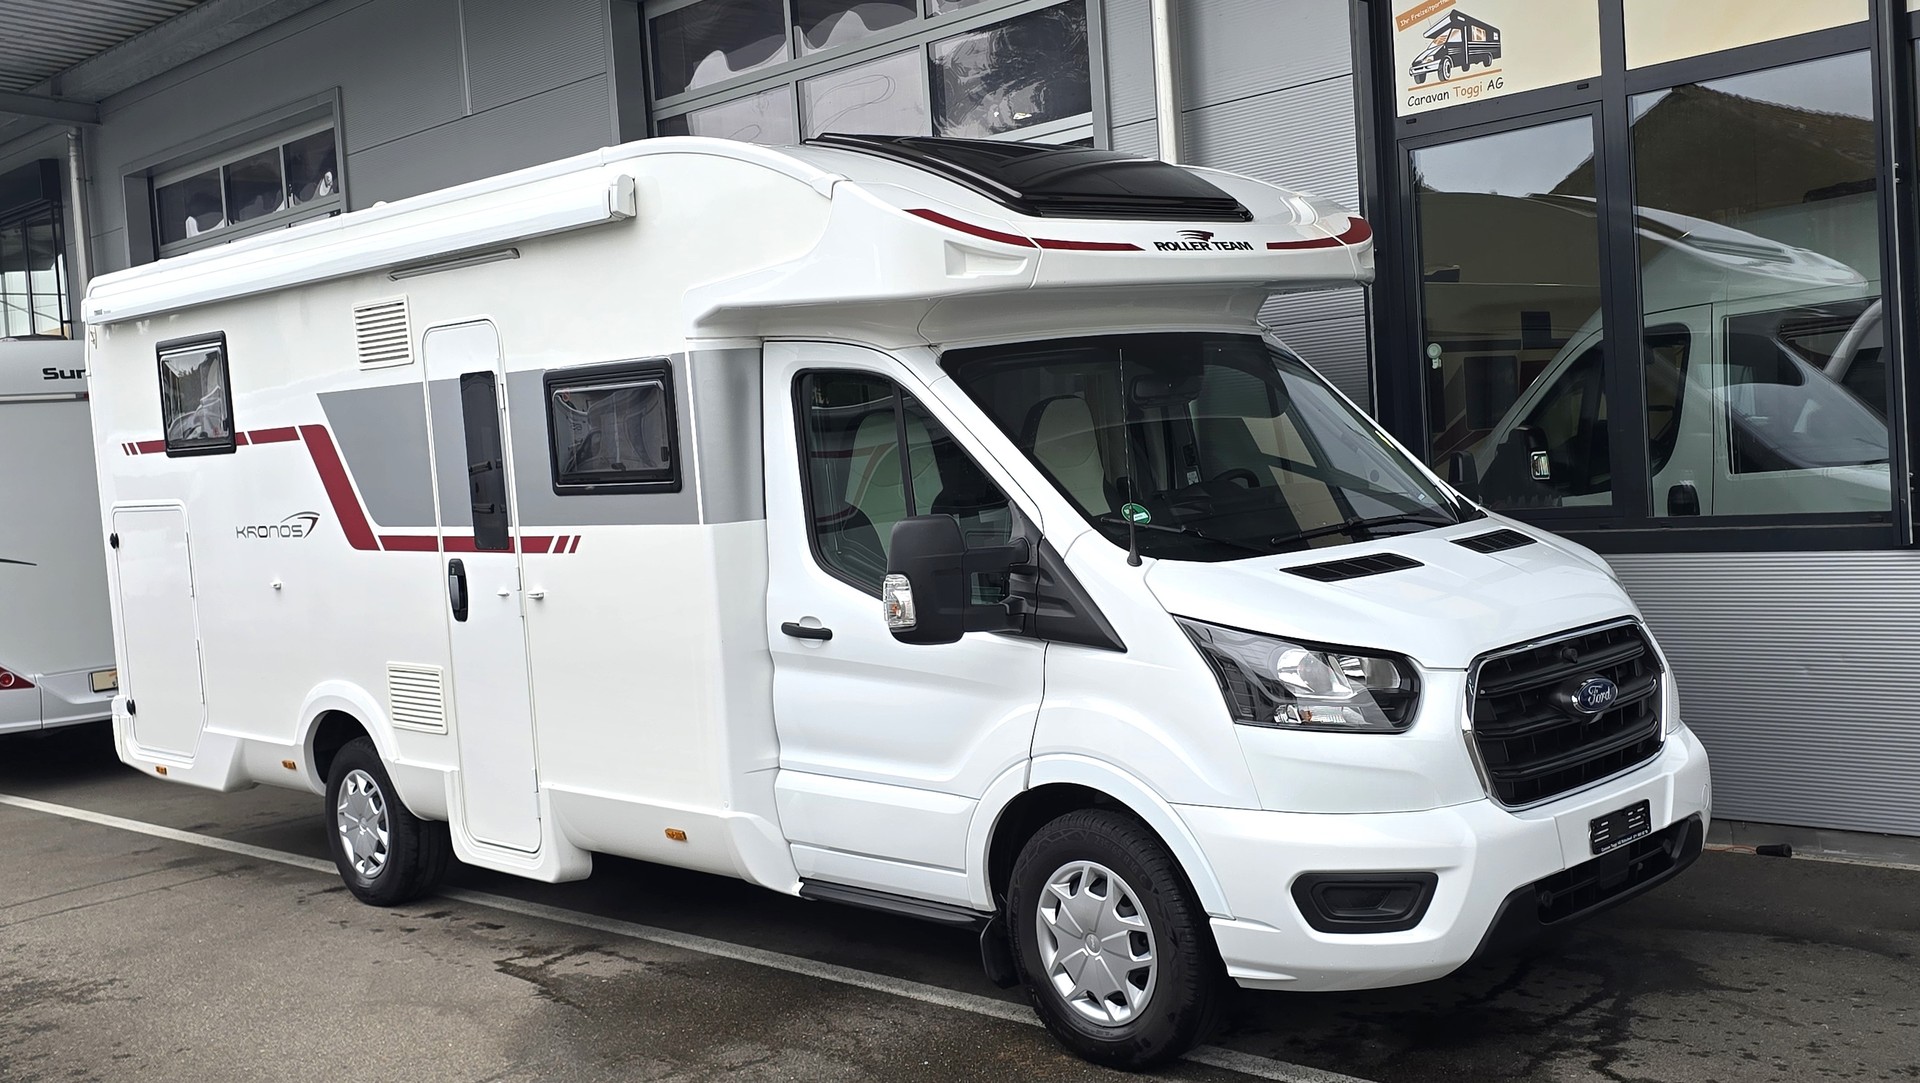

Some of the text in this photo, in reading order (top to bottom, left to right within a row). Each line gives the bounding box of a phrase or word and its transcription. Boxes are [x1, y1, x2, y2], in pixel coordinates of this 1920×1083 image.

[1400, 0, 1449, 27] Ihr Freizeitpartn
[1407, 77, 1504, 107] Caravan Toggi AG
[1153, 241, 1254, 251] ROLLER TEAM
[235, 524, 303, 539] KRONOS
[1587, 683, 1611, 706] Ford
